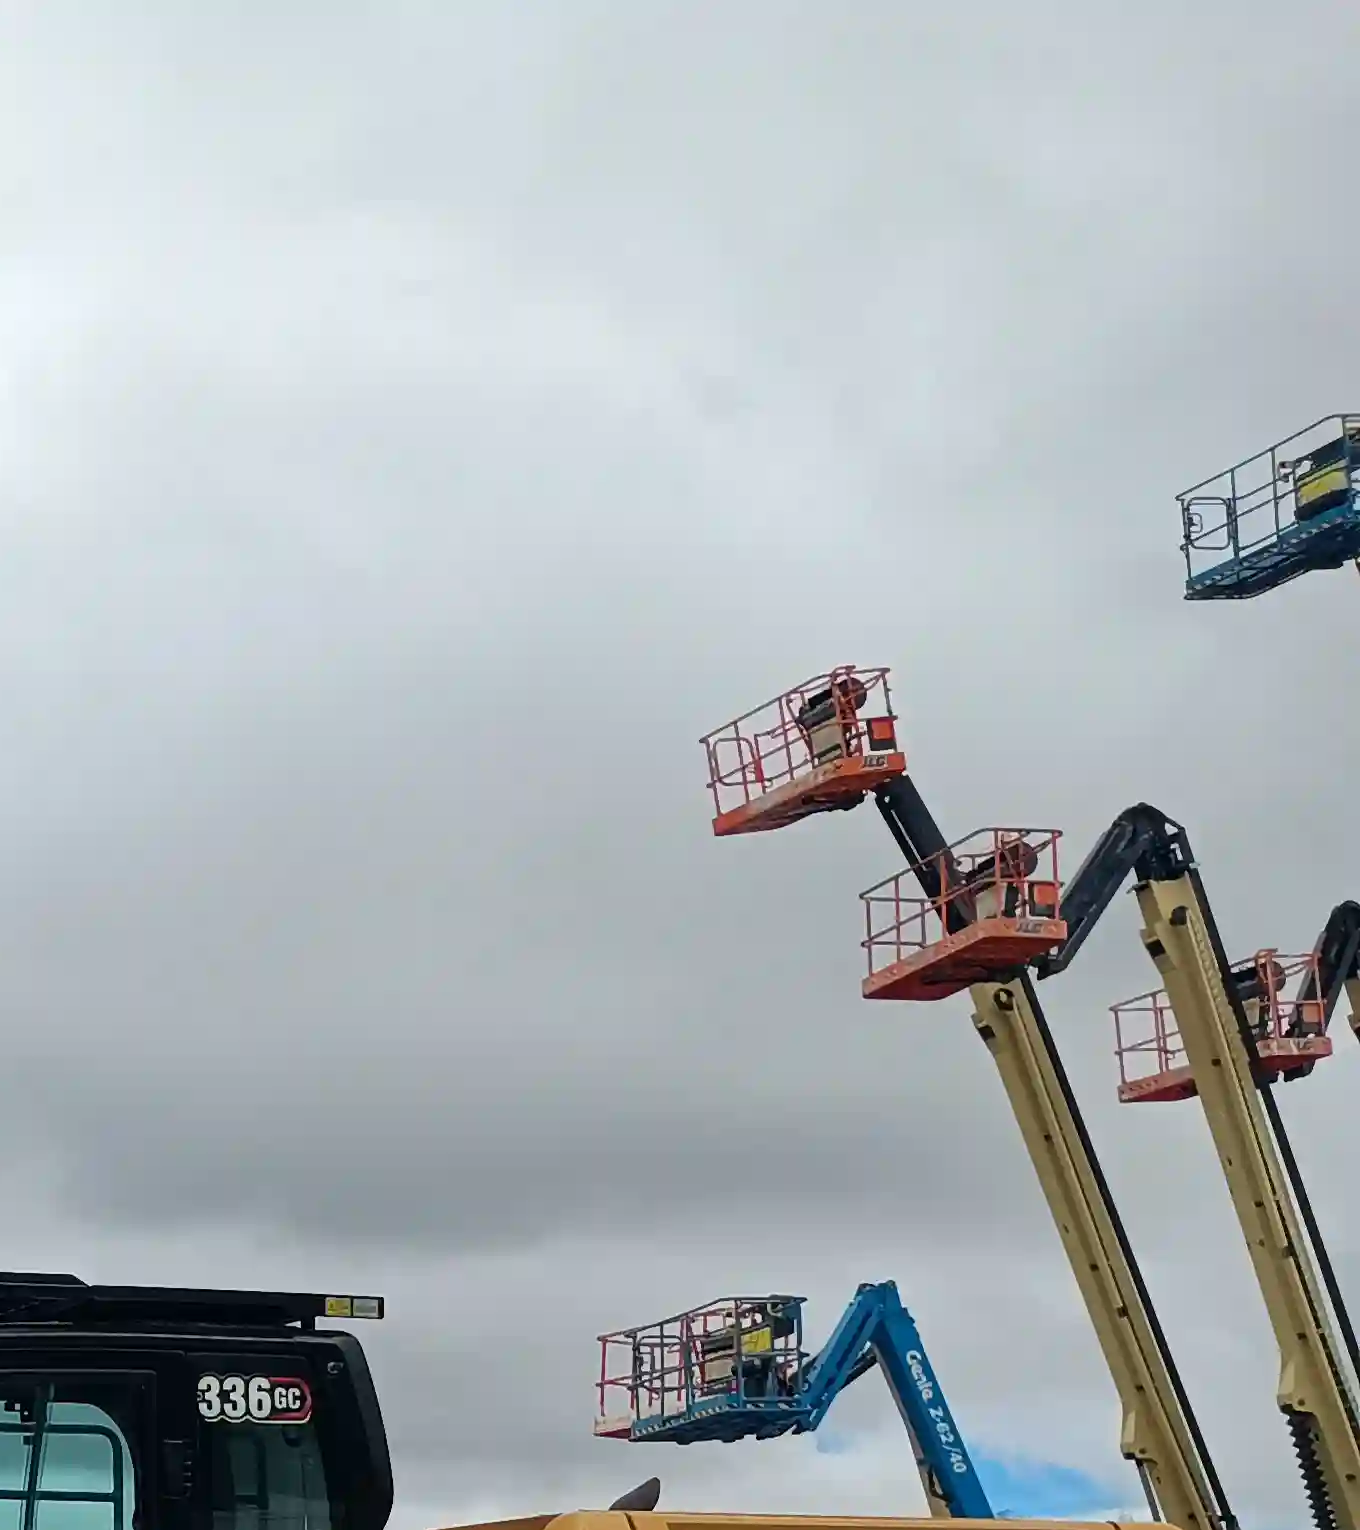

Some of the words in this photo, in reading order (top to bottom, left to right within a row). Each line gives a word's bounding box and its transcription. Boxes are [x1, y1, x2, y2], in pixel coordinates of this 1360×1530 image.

[197, 1375, 272, 1418] 336
[274, 1386, 301, 1409] GC
[905, 1349, 934, 1404] Genie
